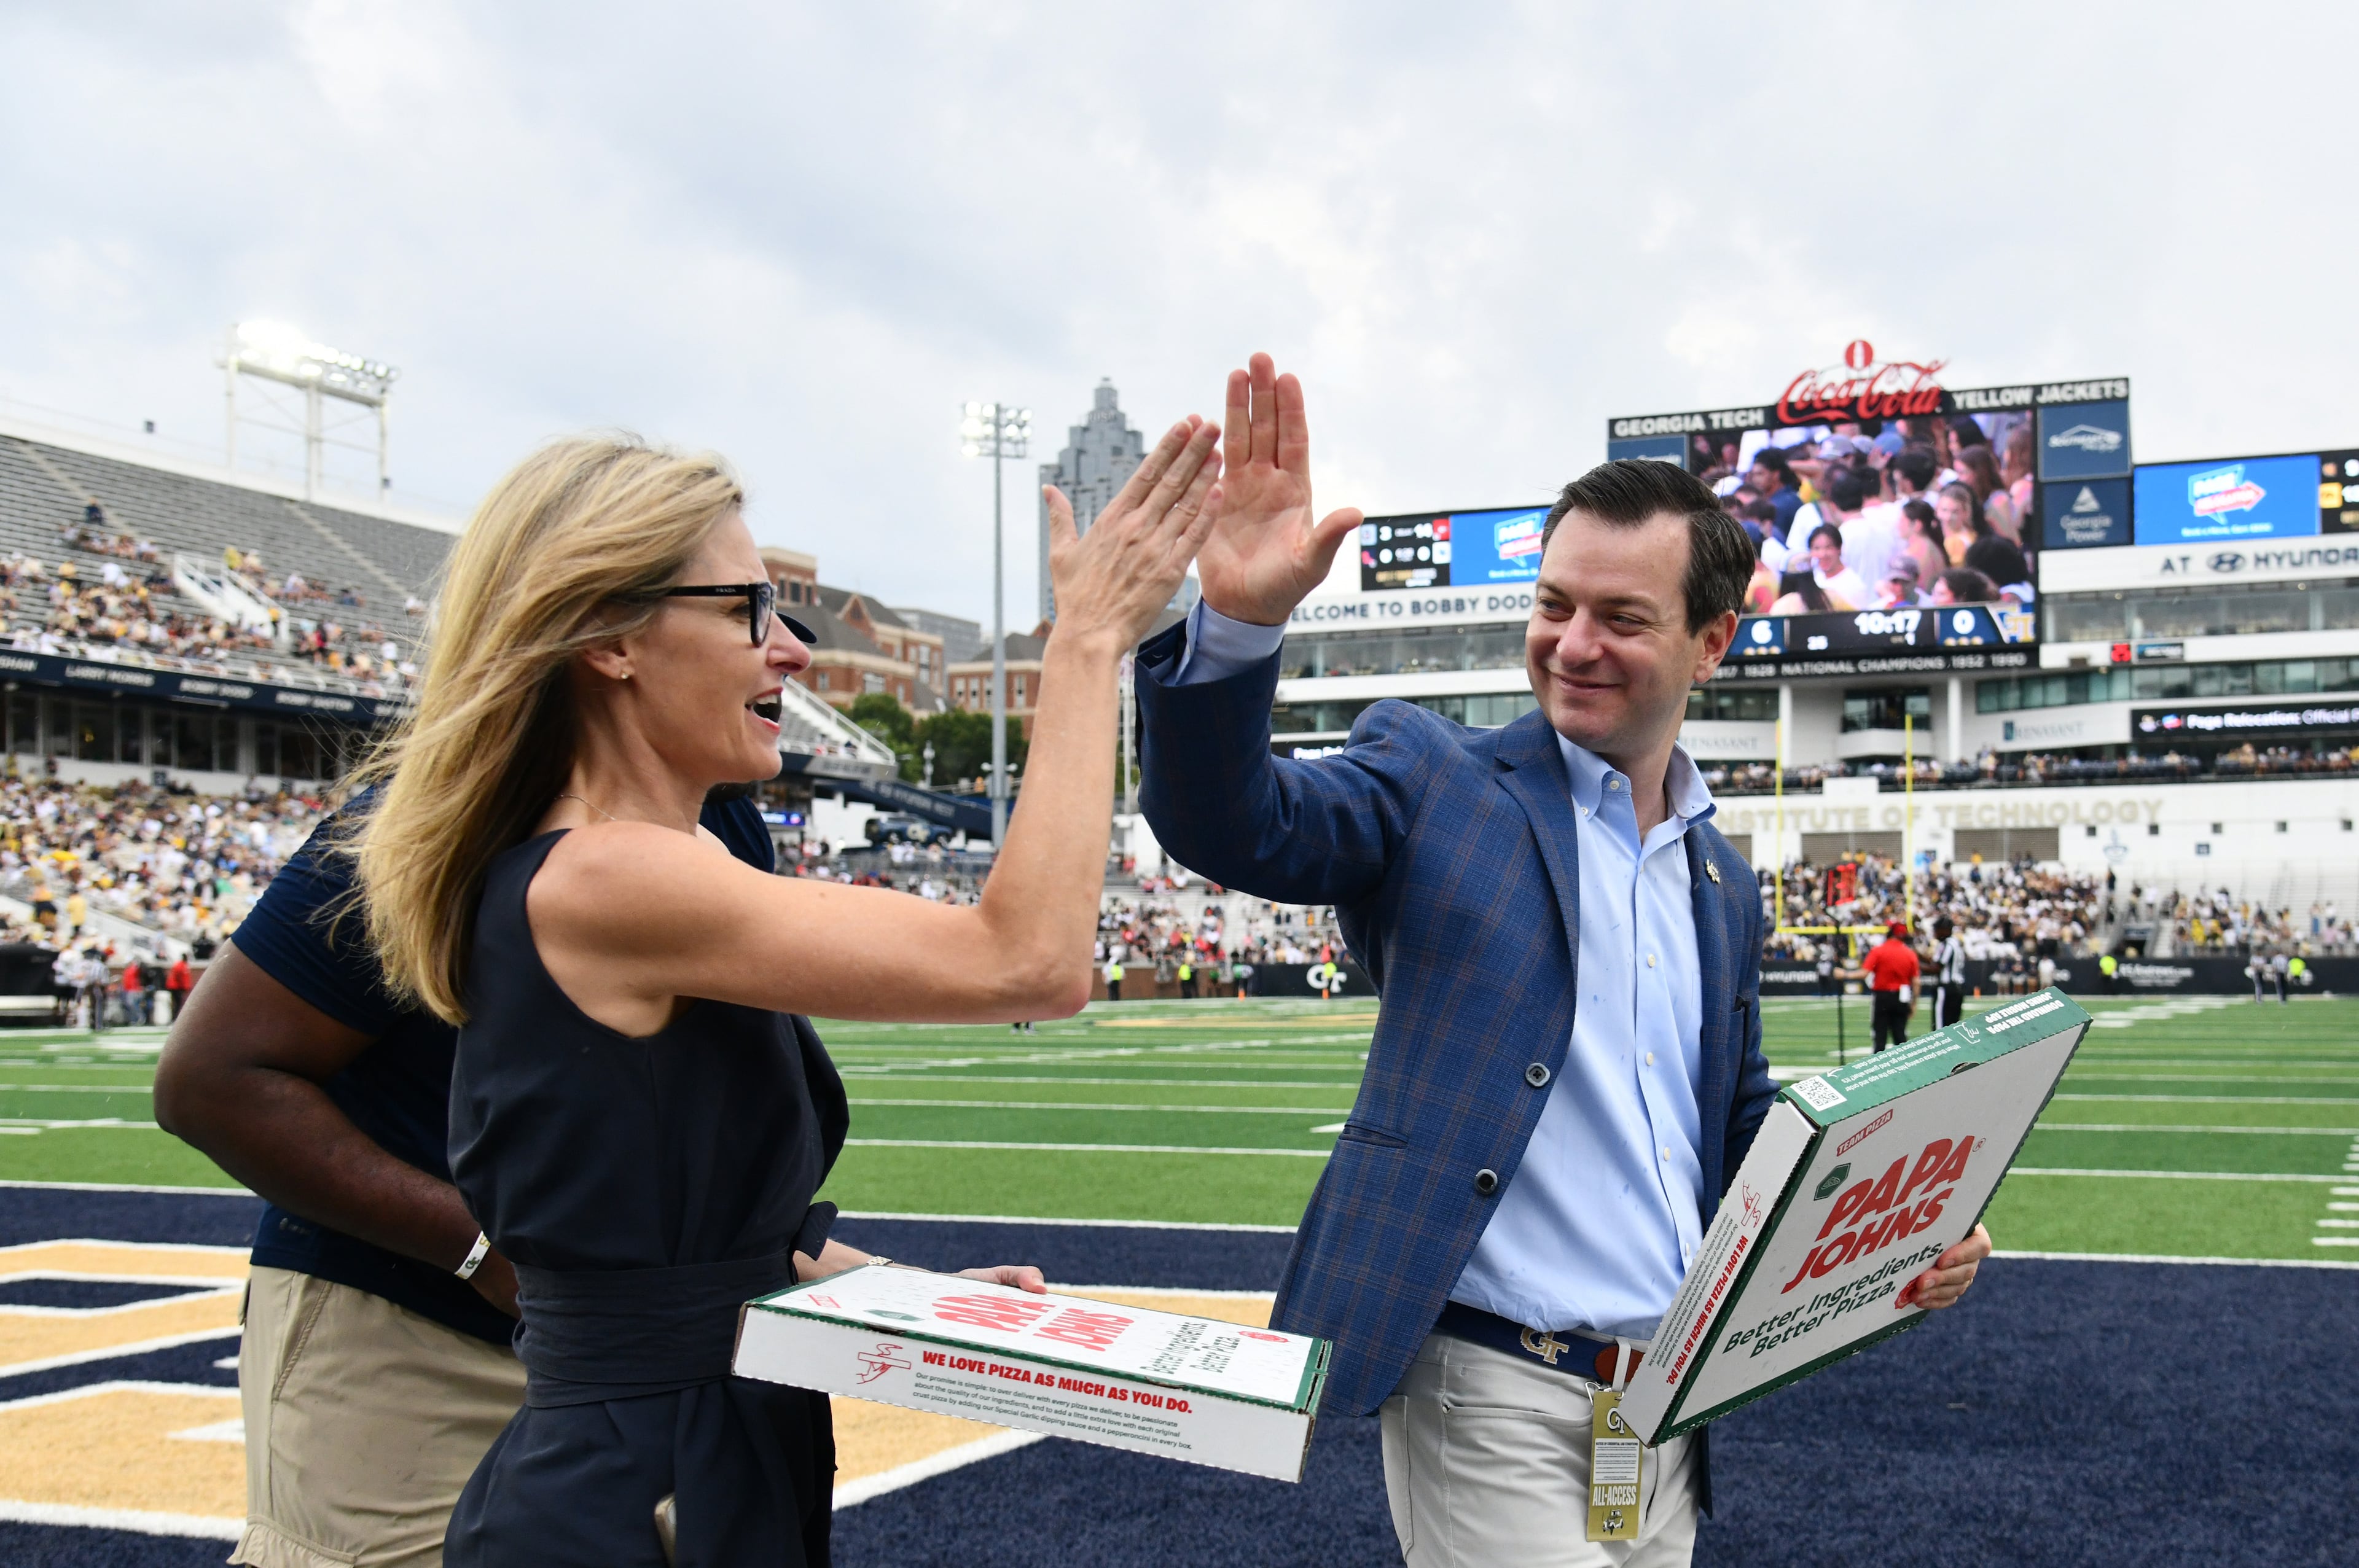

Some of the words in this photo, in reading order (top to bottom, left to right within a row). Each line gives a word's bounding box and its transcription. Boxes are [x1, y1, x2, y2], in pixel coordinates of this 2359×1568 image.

[1952, 387, 2033, 410] YELLOW
[2036, 380, 2128, 404] JACKETS
[1614, 414, 1706, 437] GEORGIA
[1709, 408, 1765, 429] TECH
[2160, 555, 2193, 574] AT
[2254, 548, 2359, 569] HYUNDA
[1291, 604, 1369, 621] ELCOME
[1378, 602, 1403, 616] TO
[1411, 598, 1479, 614] BOBBY
[1488, 595, 1532, 610] DOD
[1751, 620, 1773, 644] 6
[1854, 610, 1922, 635] 10:17
[1953, 610, 1975, 634] 0
[1713, 665, 1738, 679] 917
[1782, 660, 1856, 675] NATIONAL
[1858, 656, 1946, 673] CHAMPIONS
[1991, 652, 2027, 666] 1990
[2302, 708, 2351, 725] Official
[1717, 806, 1869, 832] NSTITUTE
[1935, 800, 2164, 828] TECHNOLOGY
[1997, 1001, 2030, 1018] MOBILE
[2020, 999, 2065, 1021] DOWNLOAD
[2025, 991, 2053, 1007] JOHNS
[1984, 1012, 2003, 1023] APP
[1985, 1021, 2011, 1034] PAPA
[2005, 1016, 2025, 1027] THE
[1922, 1051, 1937, 1061] pizza
[1944, 1043, 1962, 1052] When
[1904, 1057, 1925, 1067] craving
[1845, 1083, 1860, 1091] order
[1838, 1129, 1867, 1154] TEAM
[1866, 1112, 1892, 1137] PIZZA
[1814, 1135, 1974, 1242] PAPA
[1737, 1236, 1748, 1252] WE
[1780, 1188, 1954, 1294] JOHNS
[1724, 1250, 1740, 1274] LOVE
[1711, 1273, 1728, 1300] PIZZA
[1723, 1304, 1805, 1354] Better
[1807, 1242, 1944, 1314] Ingredients.
[932, 1294, 1057, 1332] PAPA
[1705, 1298, 1715, 1313] AS
[1033, 1308, 1135, 1352] JOHNS
[1691, 1312, 1708, 1340] MUCH
[1750, 1310, 1831, 1358] Better
[1831, 1281, 1896, 1320] Pizza.
[1155, 1322, 1209, 1355] Ingredients.
[1201, 1336, 1242, 1354] Pizza.
[1684, 1338, 1693, 1352] AS
[1140, 1352, 1186, 1375] Better
[1189, 1352, 1232, 1373] Better
[1675, 1351, 1688, 1372] YOU
[923, 1351, 946, 1366] WE
[949, 1356, 985, 1374] LOVE
[988, 1363, 1031, 1383] PIZZA
[1035, 1373, 1055, 1387] AS
[1058, 1377, 1105, 1397] MUCH
[1108, 1387, 1128, 1401] AS
[1132, 1391, 1164, 1408] YOU
[1166, 1397, 1192, 1413] DO.
[1666, 1368, 1679, 1384] DO.
[928, 1375, 957, 1385] promise
[964, 1382, 988, 1391] simple:
[1012, 1391, 1036, 1400] deliver
[1051, 1399, 1070, 1408] every
[1099, 1407, 1122, 1418] deliver,
[1141, 1416, 1178, 1427] passionate
[947, 1388, 970, 1398] quality
[991, 1397, 1030, 1410] ingredients,
[1073, 1411, 1089, 1420] little
[1154, 1428, 1180, 1437] original
[958, 1400, 982, 1410] adding
[995, 1406, 1019, 1416] Special
[1020, 1411, 1039, 1420] Garlic
[1040, 1415, 1066, 1426] dipping
[1066, 1421, 1087, 1429] sauce
[1106, 1429, 1151, 1441] pepperoncini
[1159, 1438, 1177, 1448] every
[1592, 1485, 1637, 1507] ALL-ACCESS
